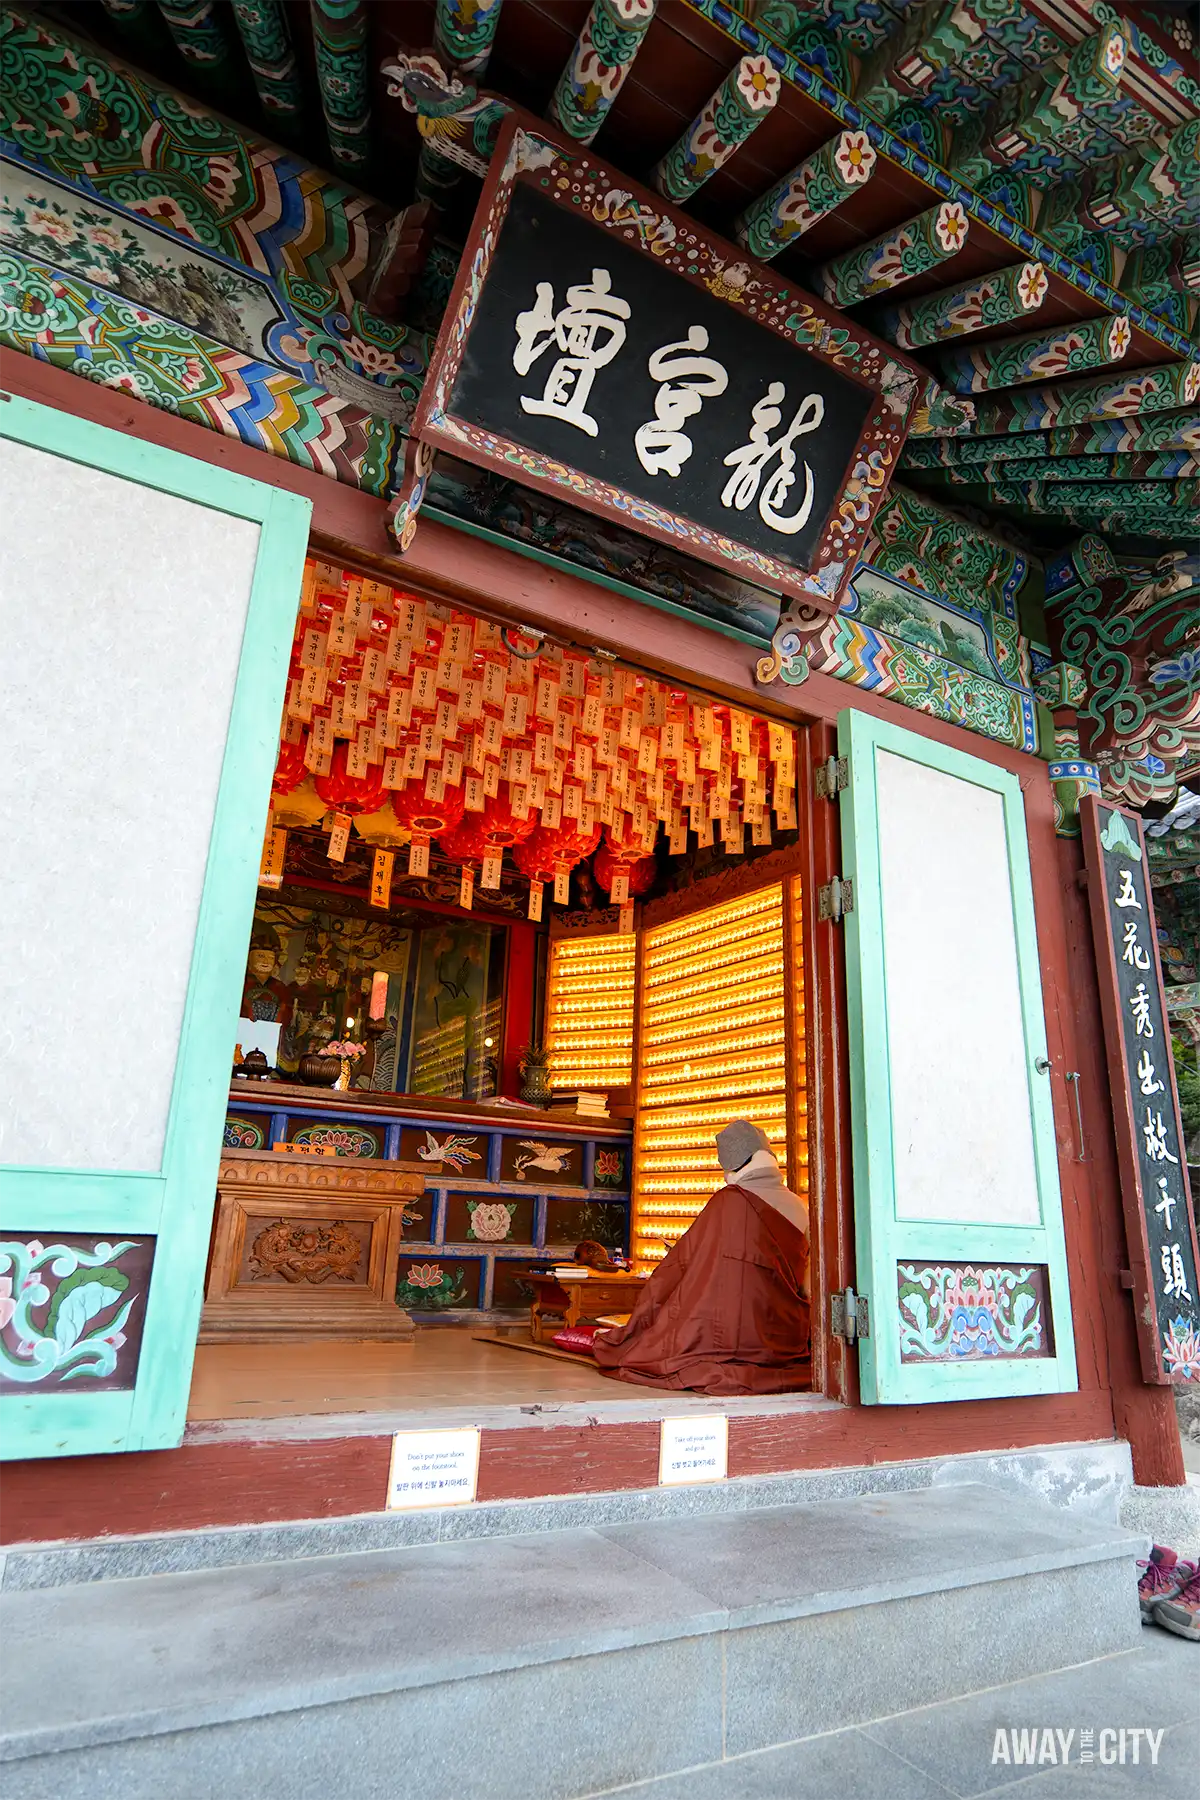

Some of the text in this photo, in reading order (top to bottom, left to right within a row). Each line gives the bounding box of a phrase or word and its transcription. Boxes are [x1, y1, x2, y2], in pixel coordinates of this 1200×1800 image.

[407, 1453, 423, 1461] Don't
[449, 1450, 465, 1458] shoes
[424, 1480, 437, 1490] 신발
